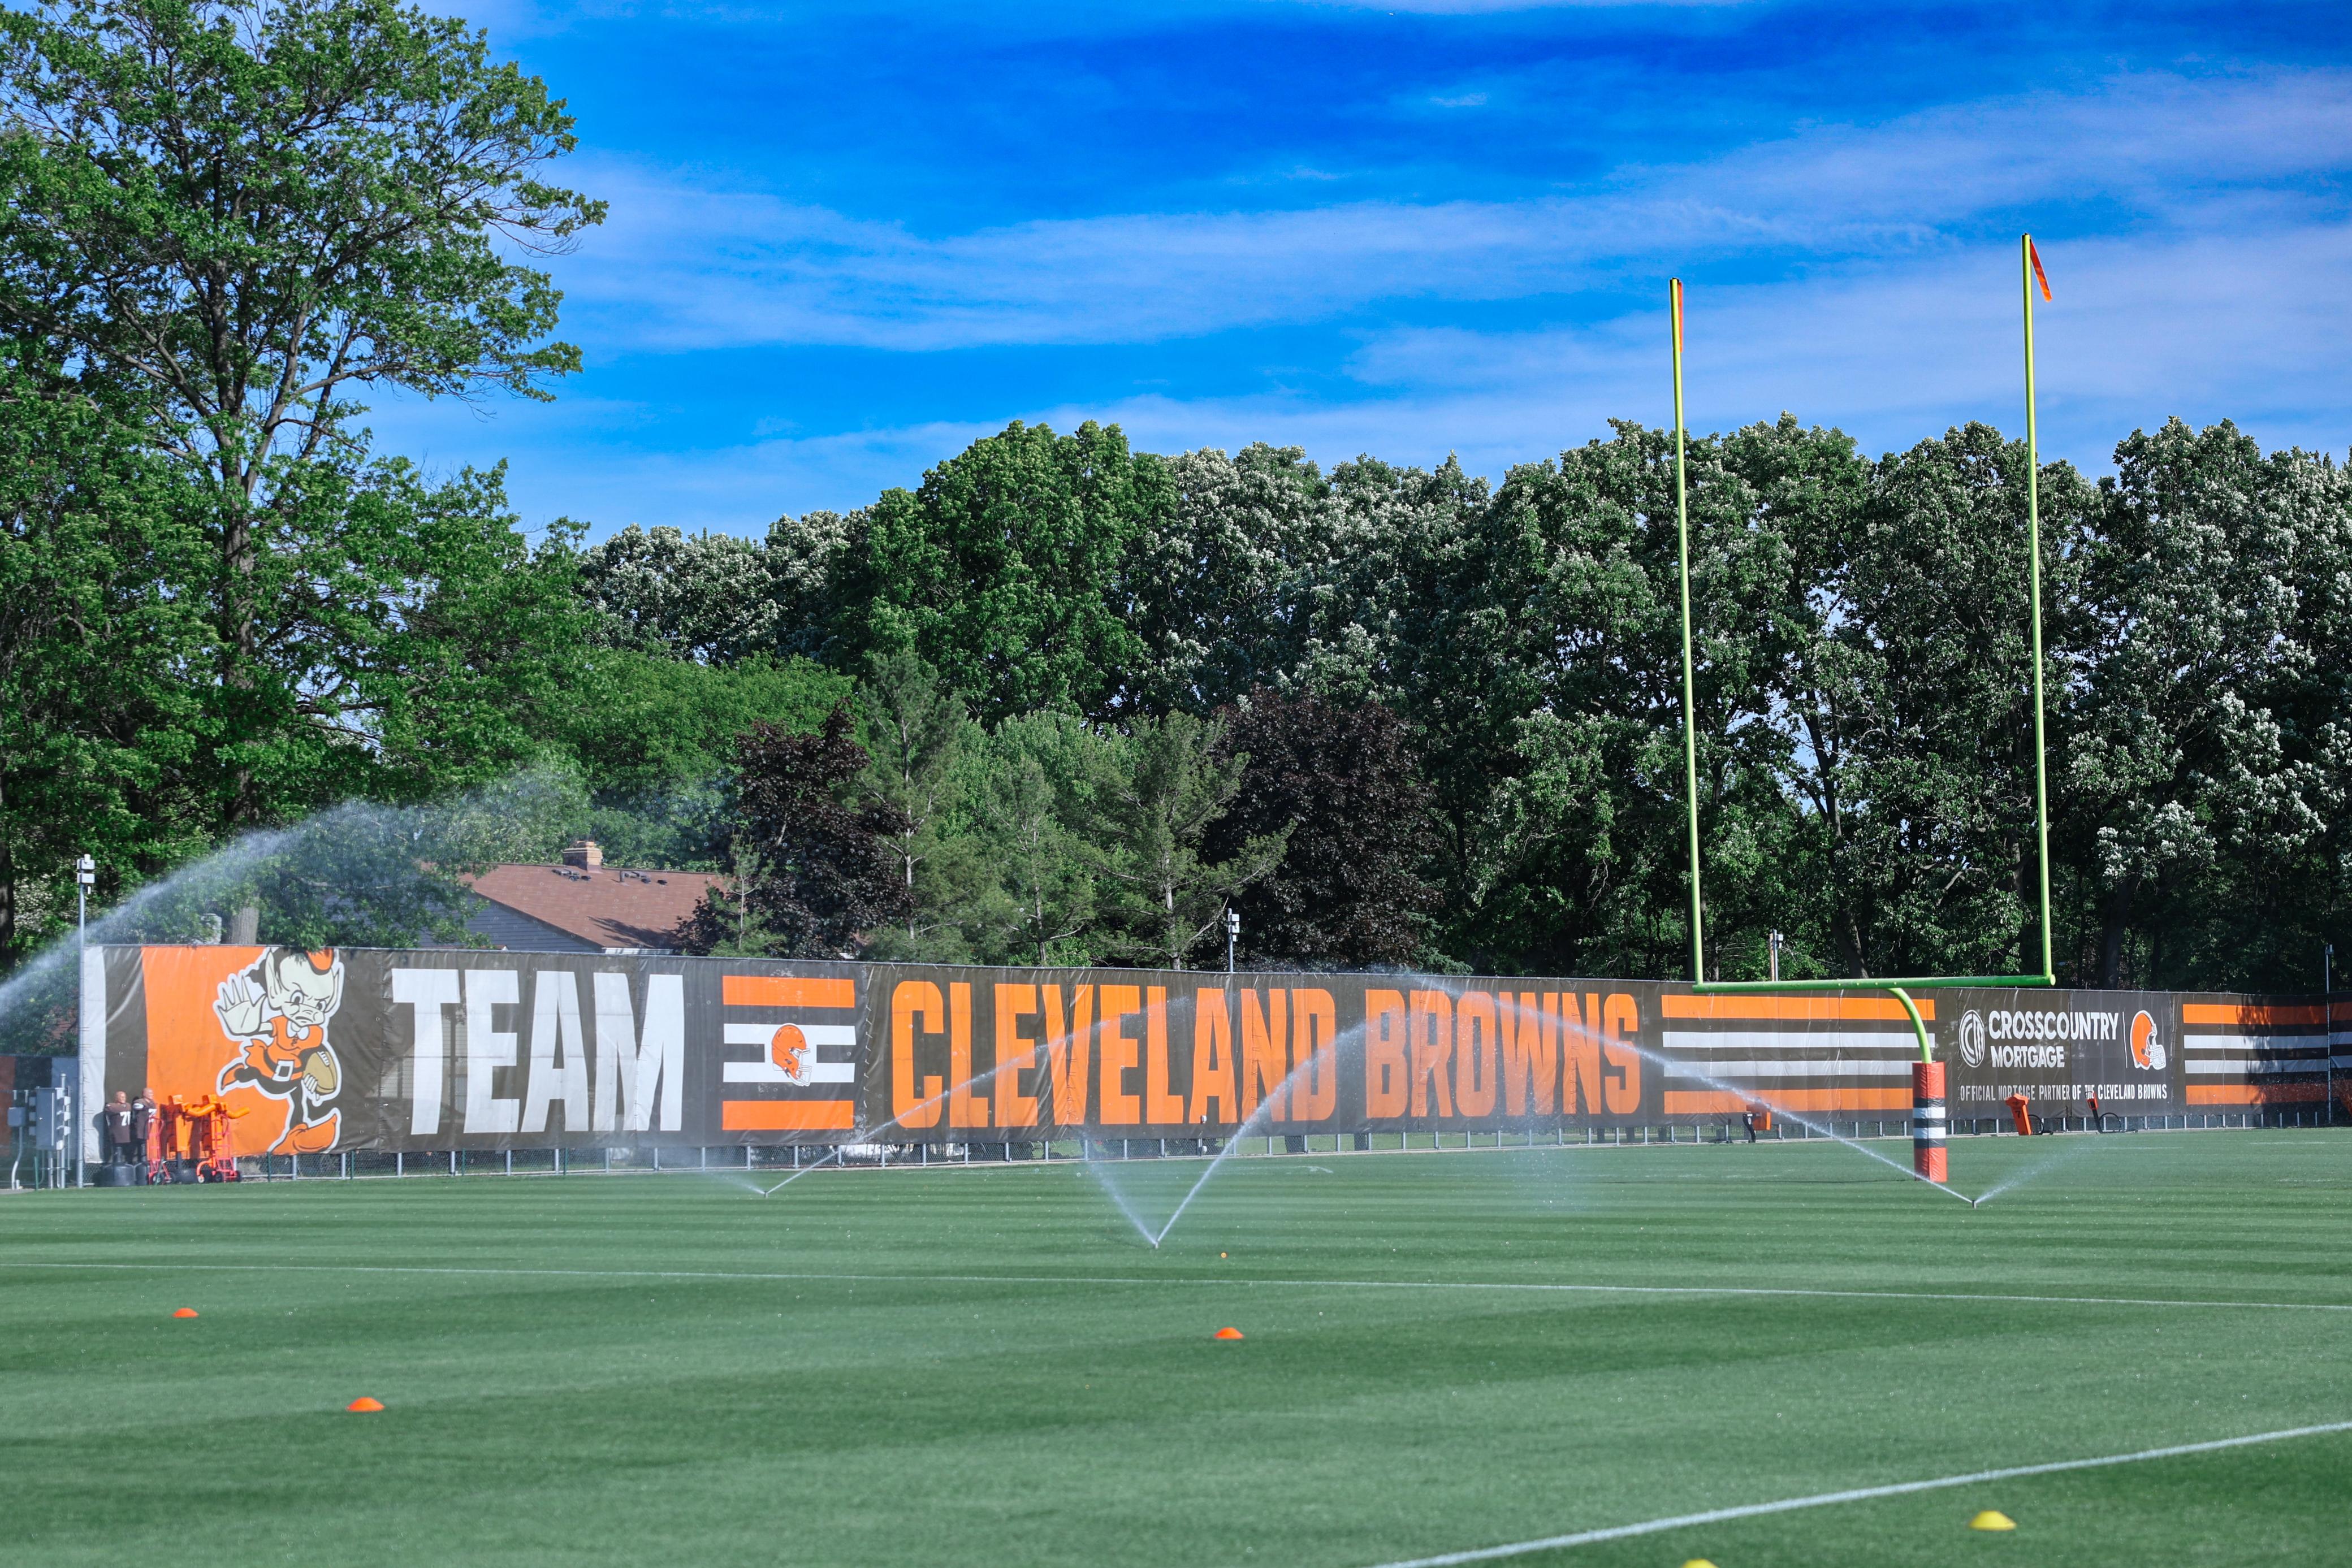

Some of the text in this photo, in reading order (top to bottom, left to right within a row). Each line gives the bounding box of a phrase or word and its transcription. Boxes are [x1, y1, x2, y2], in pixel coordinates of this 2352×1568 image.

[1988, 1010, 2119, 1040] CROSSCOUNTRY
[392, 968, 1641, 1134] TEAM CLEVELAND BROWNS
[1990, 1045, 2065, 1068] MORTGAGE
[1960, 1085, 1996, 1101] OFFICIAL
[2039, 1085, 2070, 1101] PARTNER
[2072, 1084, 2082, 1100] OF
[2085, 1084, 2095, 1099] THE
[2098, 1084, 2135, 1100] CLEVELAND
[2138, 1084, 2167, 1099] BROWNS
